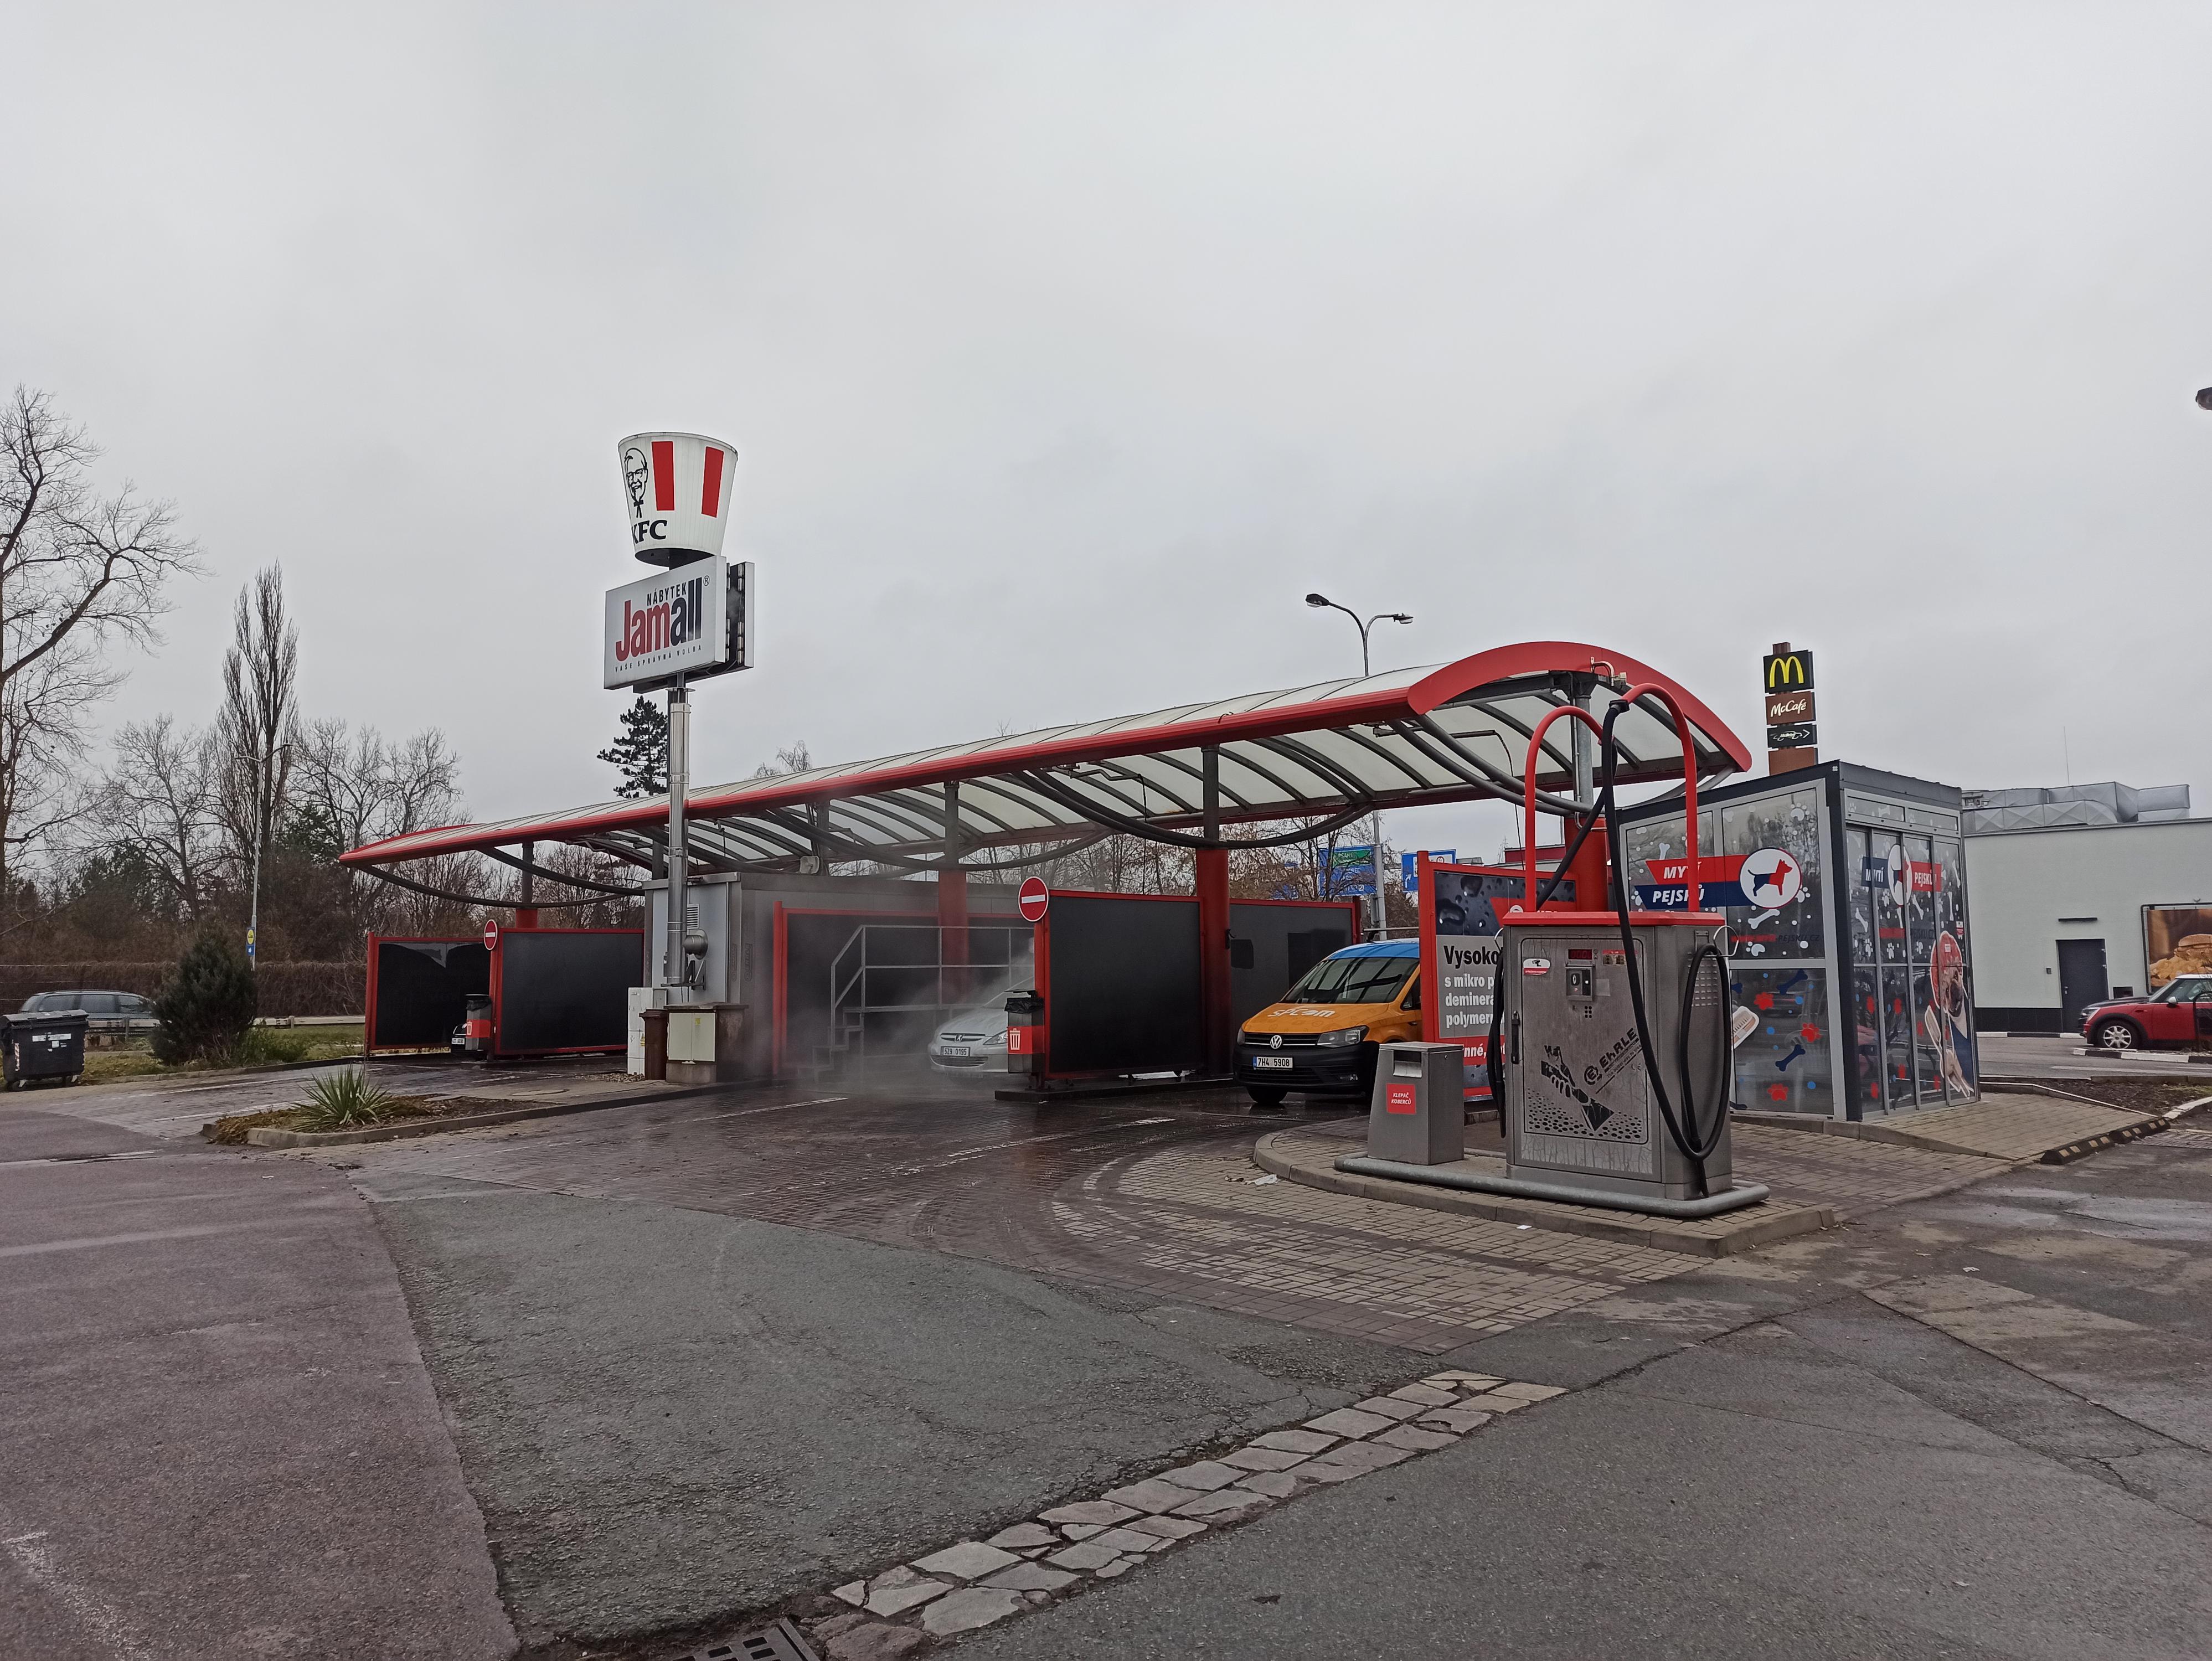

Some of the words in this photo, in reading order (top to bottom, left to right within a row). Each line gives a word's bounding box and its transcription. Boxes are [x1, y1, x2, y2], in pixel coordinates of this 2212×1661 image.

[632, 520, 667, 544] KFC
[647, 582, 686, 606] NÁBYTEK
[616, 577, 702, 662] Jamall
[615, 663, 632, 673] VAŠE
[638, 652, 671, 667] SPRÁVNÁ
[677, 645, 701, 656] VOLBA
[1770, 699, 1807, 717] McCafé
[1443, 946, 1502, 969] Vysoko
[1445, 977, 1451, 987] s
[1454, 973, 1485, 987] mikro
[1446, 992, 1493, 1007] deminera
[1273, 1058, 1290, 1067] 5908
